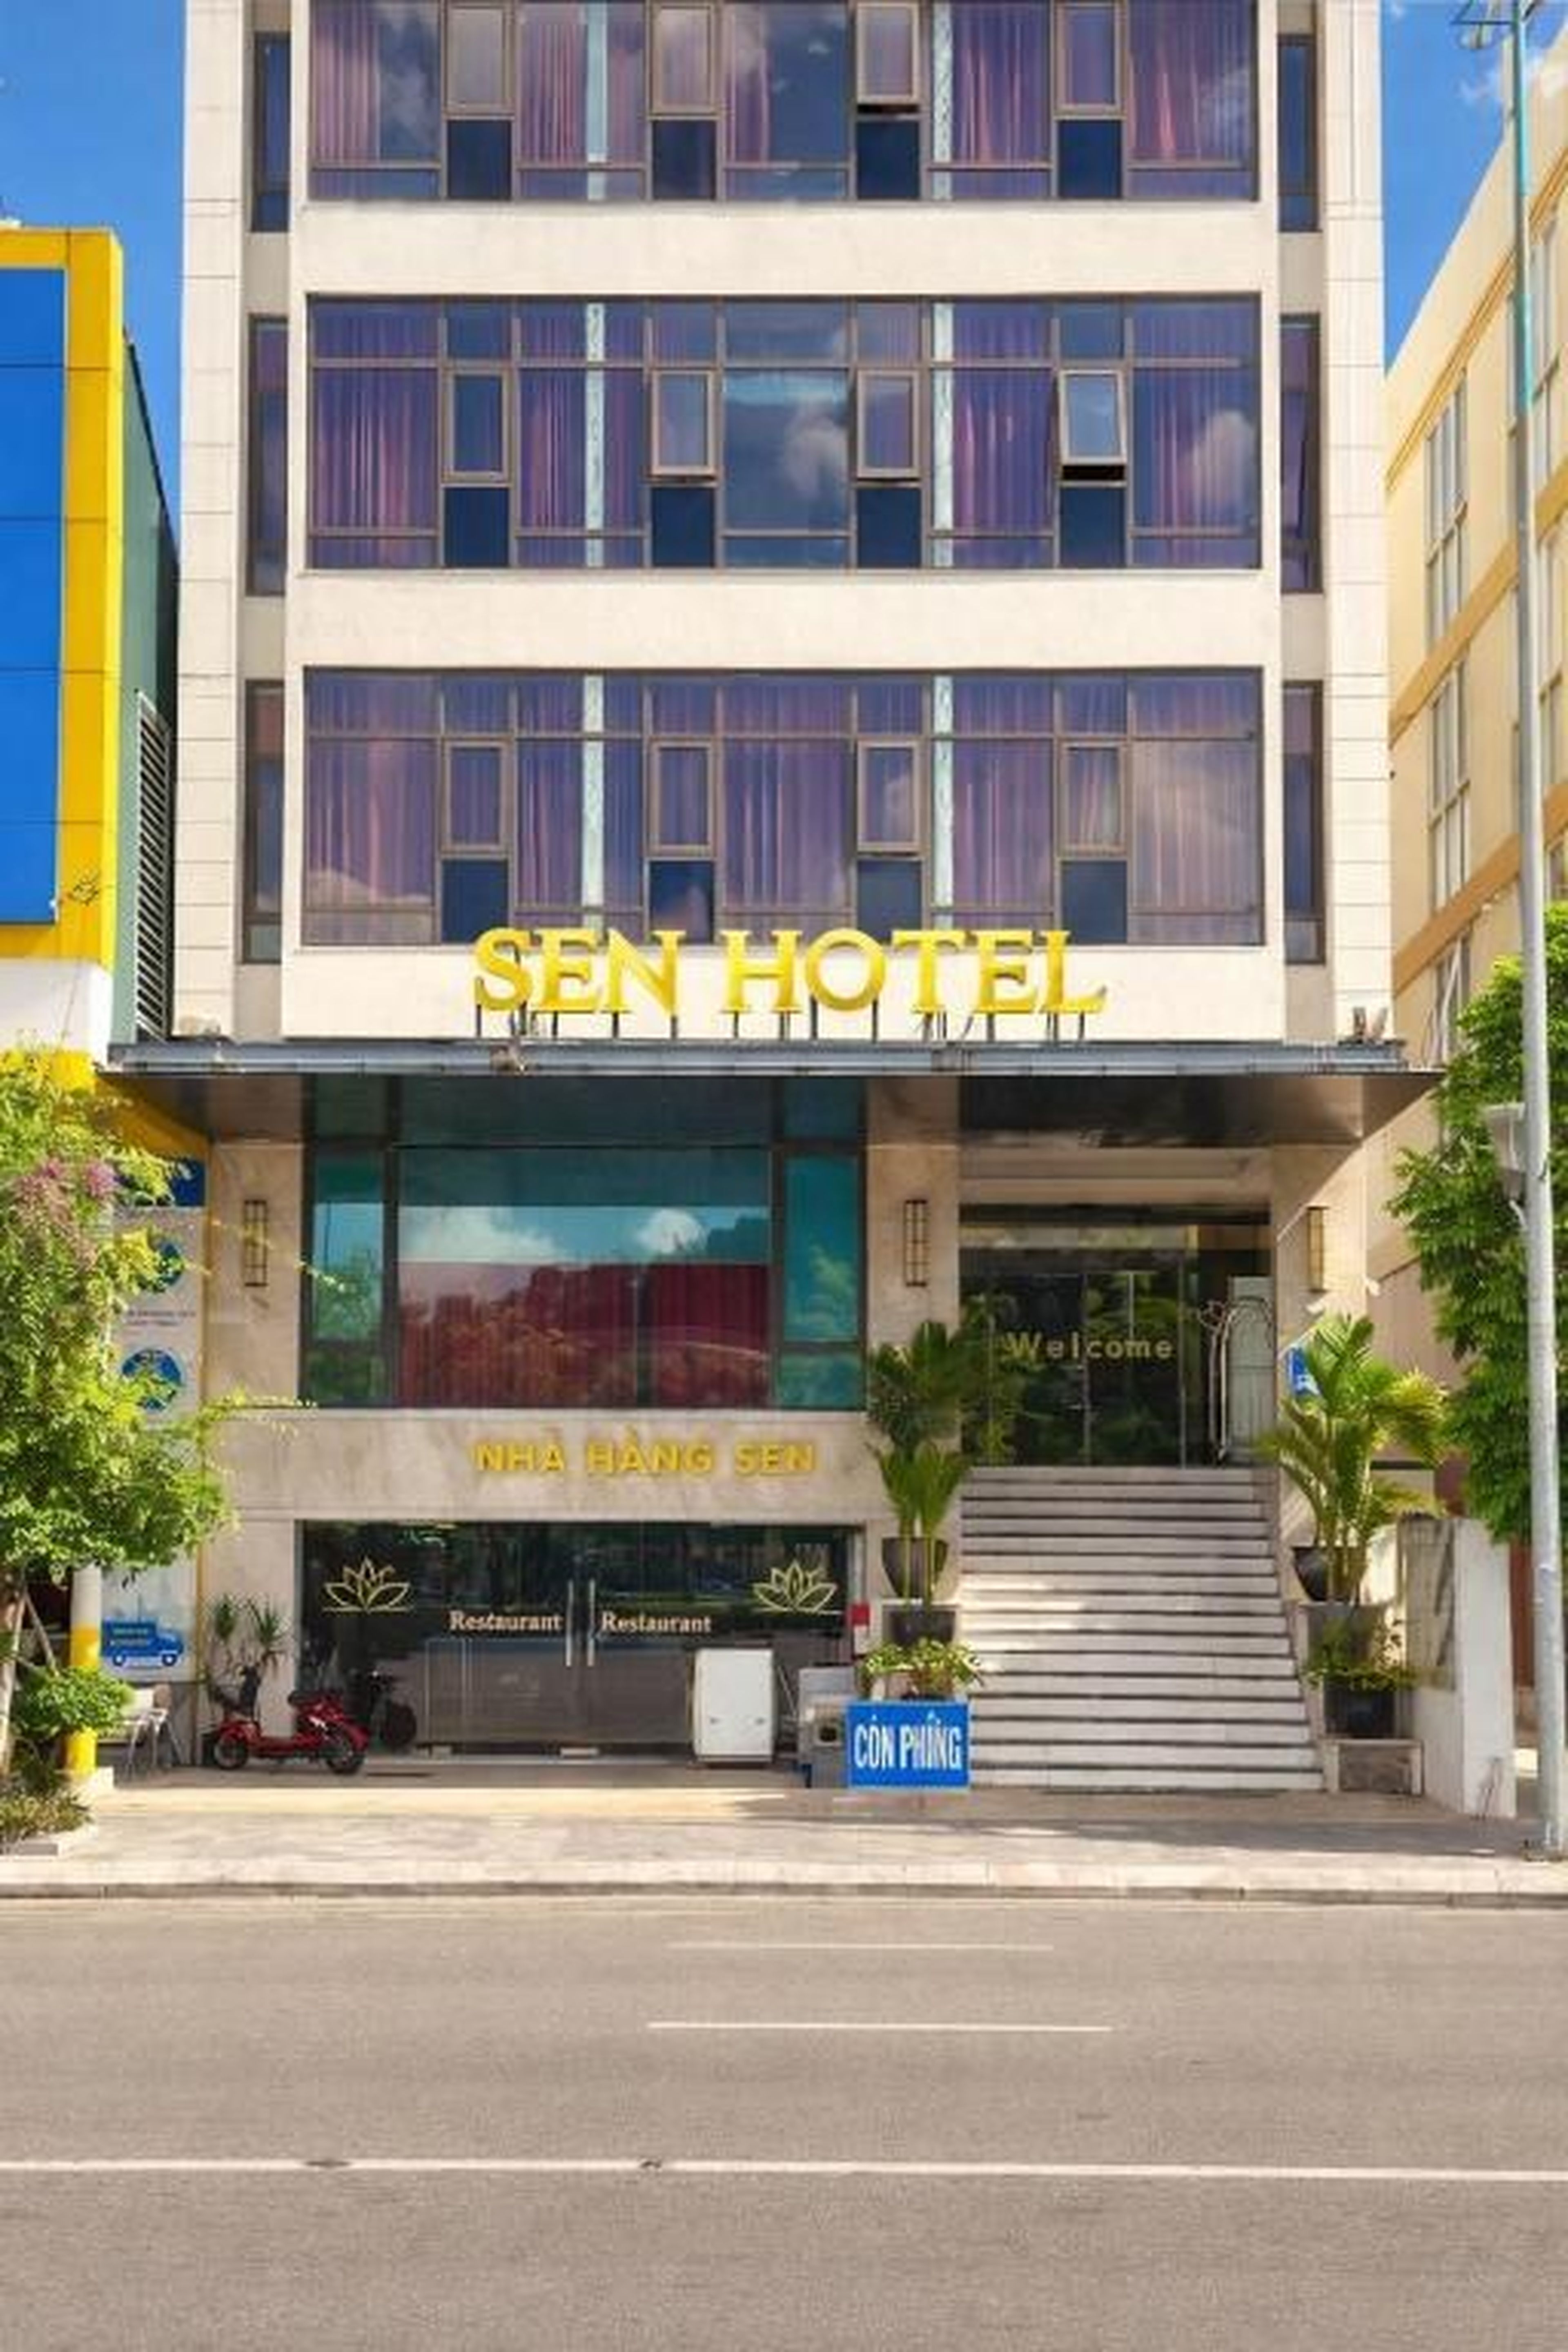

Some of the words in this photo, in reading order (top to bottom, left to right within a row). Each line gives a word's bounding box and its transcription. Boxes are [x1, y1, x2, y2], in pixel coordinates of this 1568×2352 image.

[474, 928, 687, 1015] SEN
[718, 928, 1107, 1015] HOTEL
[1003, 1330, 1174, 1361] Welcome
[734, 1443, 815, 1474] SEN
[449, 1610, 564, 1631] Restaurant
[601, 1610, 711, 1633] Restaurant
